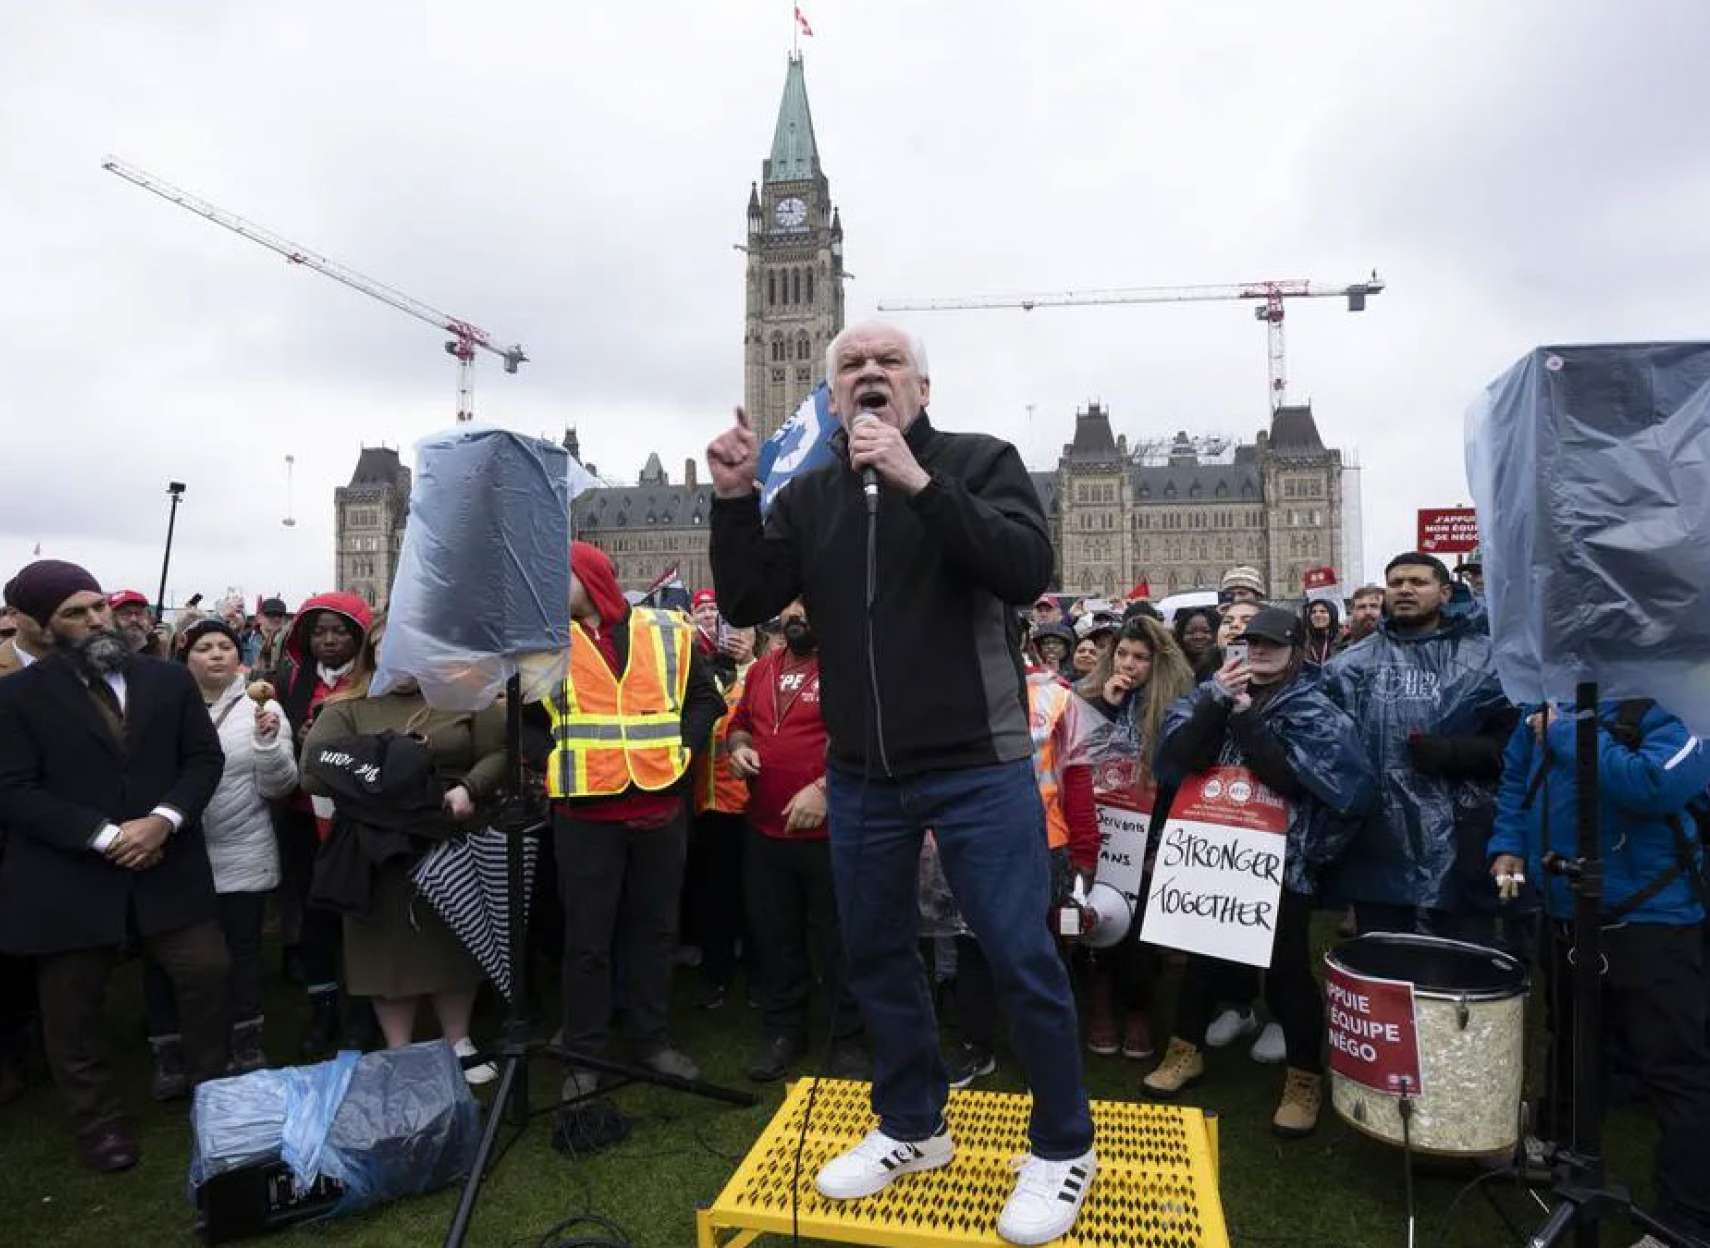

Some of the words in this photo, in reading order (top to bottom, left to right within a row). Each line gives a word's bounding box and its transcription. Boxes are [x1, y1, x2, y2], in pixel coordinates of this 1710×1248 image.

[1425, 524, 1450, 532] MON
[1433, 533, 1448, 541] DE
[1163, 827, 1281, 886] STRONGER
[1150, 874, 1273, 931] TOGETHER
[1331, 1003, 1401, 1042] ÉQUIPE
[1328, 1027, 1378, 1063] NÉGO
